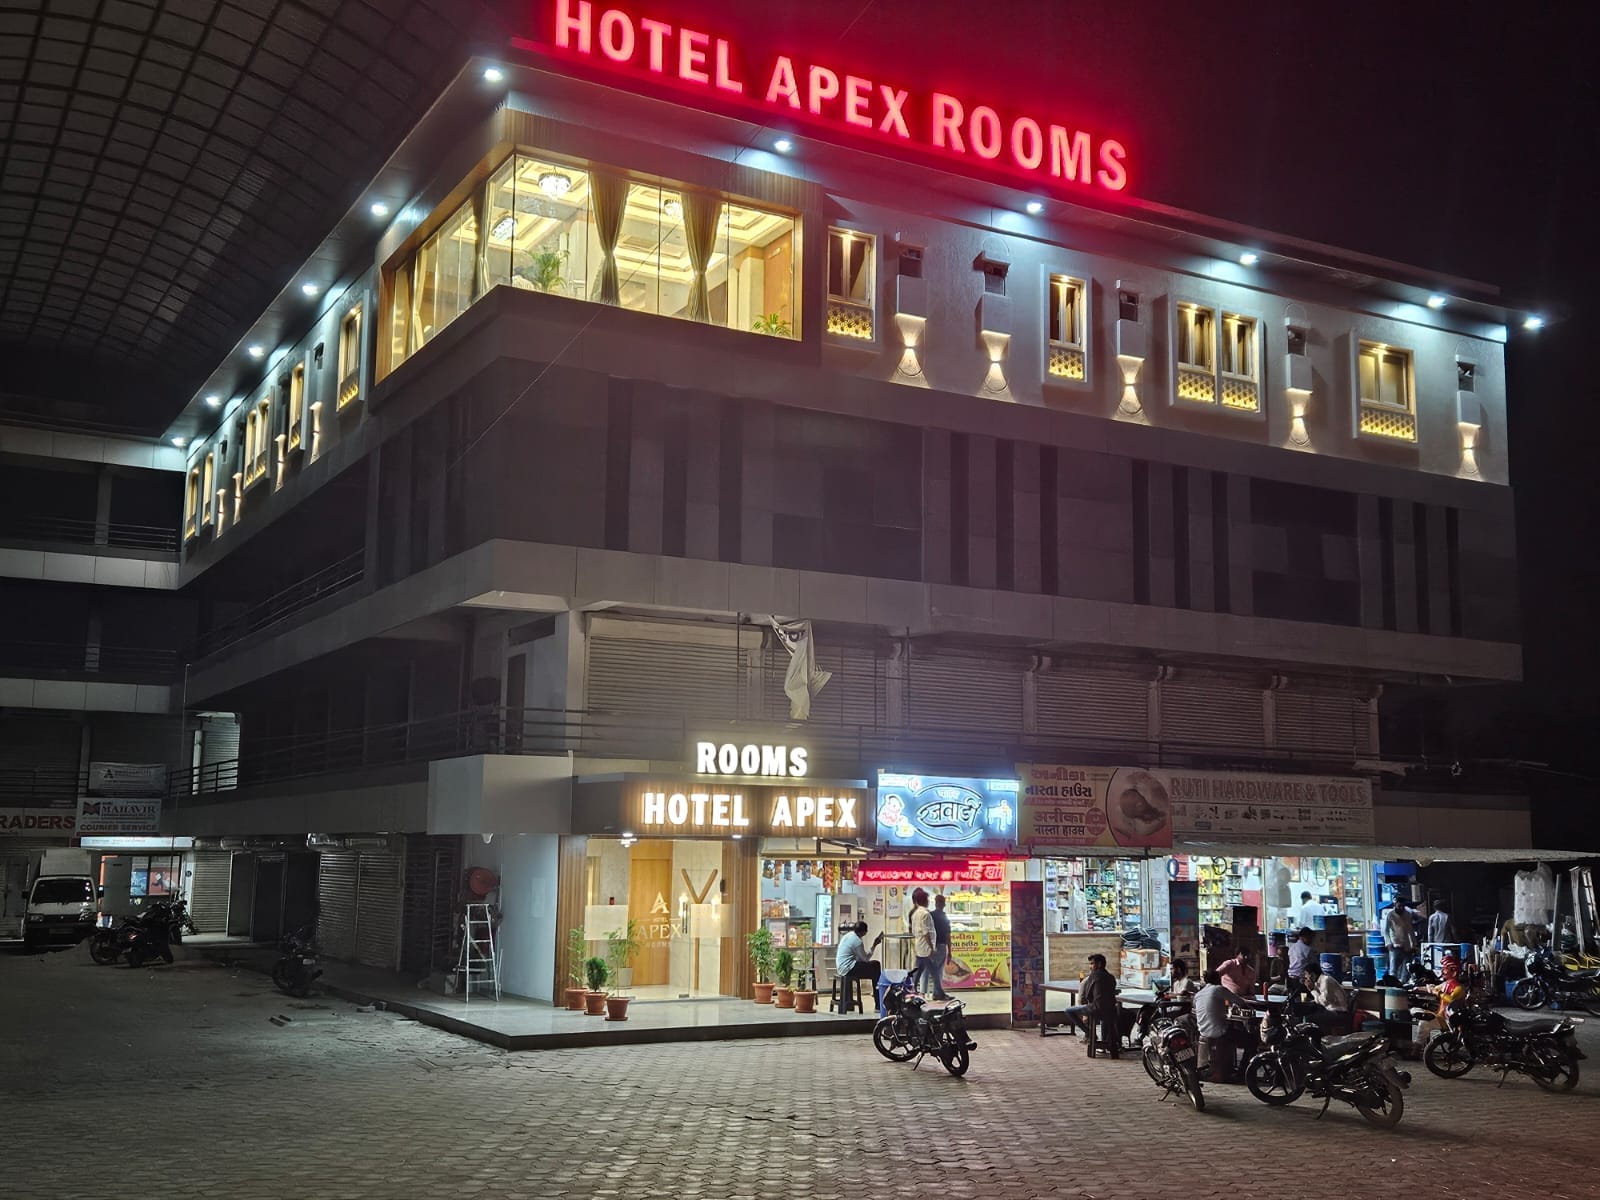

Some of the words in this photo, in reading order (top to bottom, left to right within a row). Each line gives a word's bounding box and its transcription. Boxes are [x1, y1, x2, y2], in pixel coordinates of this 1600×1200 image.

[555, 0, 743, 94] HOTEL
[765, 55, 910, 139] APEX
[931, 91, 1128, 192] ROOMS
[696, 742, 808, 777] ROOMS
[1212, 779, 1301, 802] HARDWARE
[1318, 783, 1369, 804] TOOLS
[643, 792, 750, 827] HOTEL
[771, 796, 857, 829] APEX
[636, 924, 682, 939] APEX
